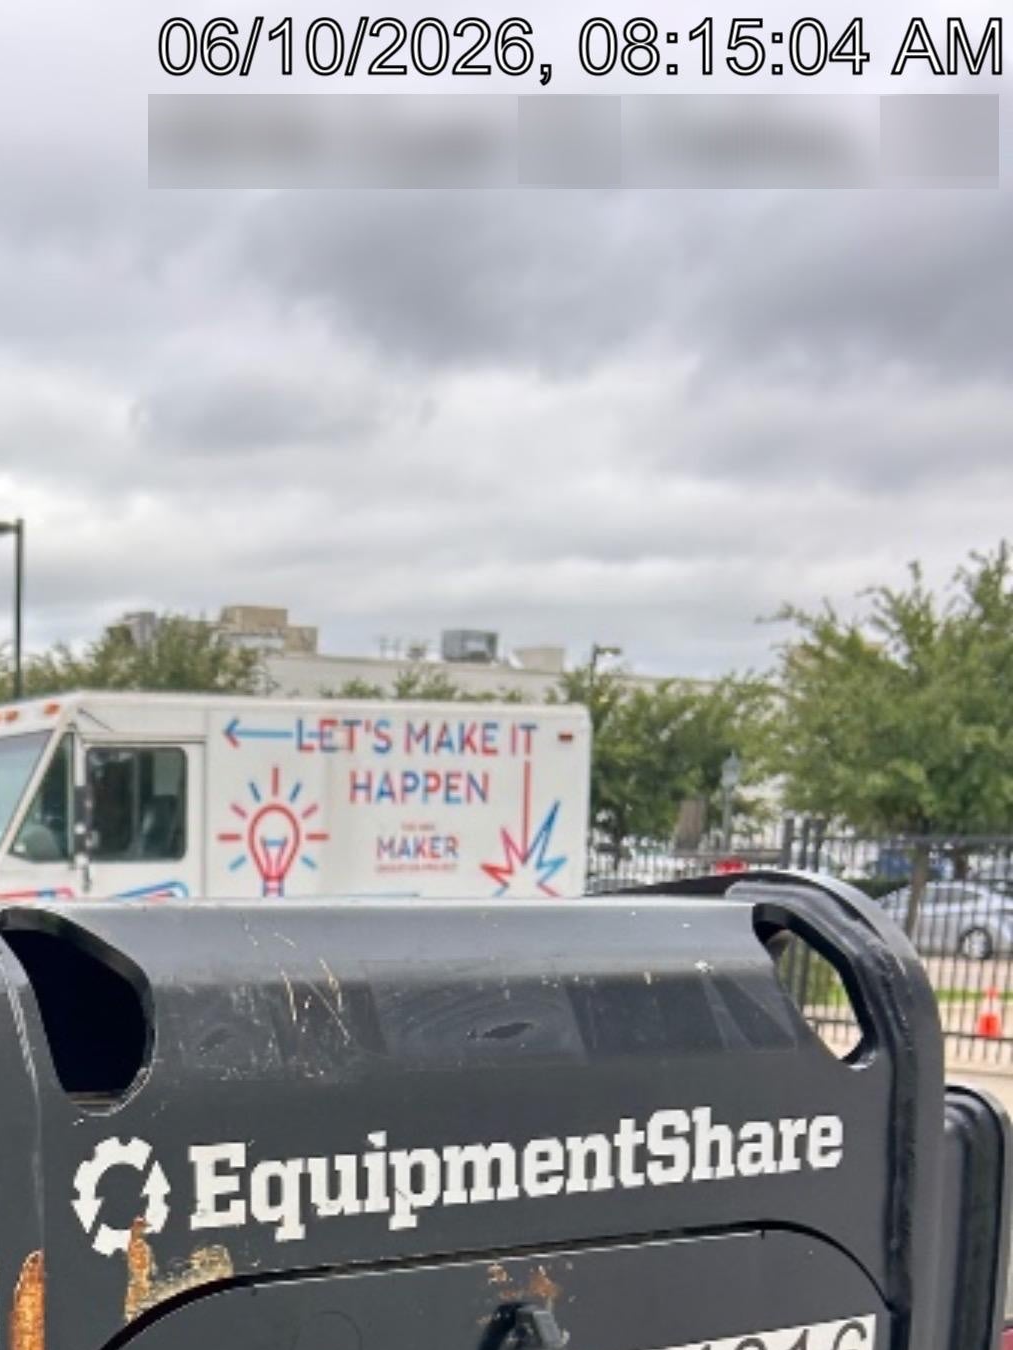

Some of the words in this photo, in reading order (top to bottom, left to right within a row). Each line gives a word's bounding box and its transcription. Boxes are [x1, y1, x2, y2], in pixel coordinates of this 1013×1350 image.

[296, 718, 392, 754] LET'S
[403, 721, 499, 756] MAKE
[510, 723, 538, 756] IT
[349, 769, 489, 805] HAPPEN
[376, 835, 460, 860] MAKER
[189, 1107, 844, 1242] EquipmentShare
